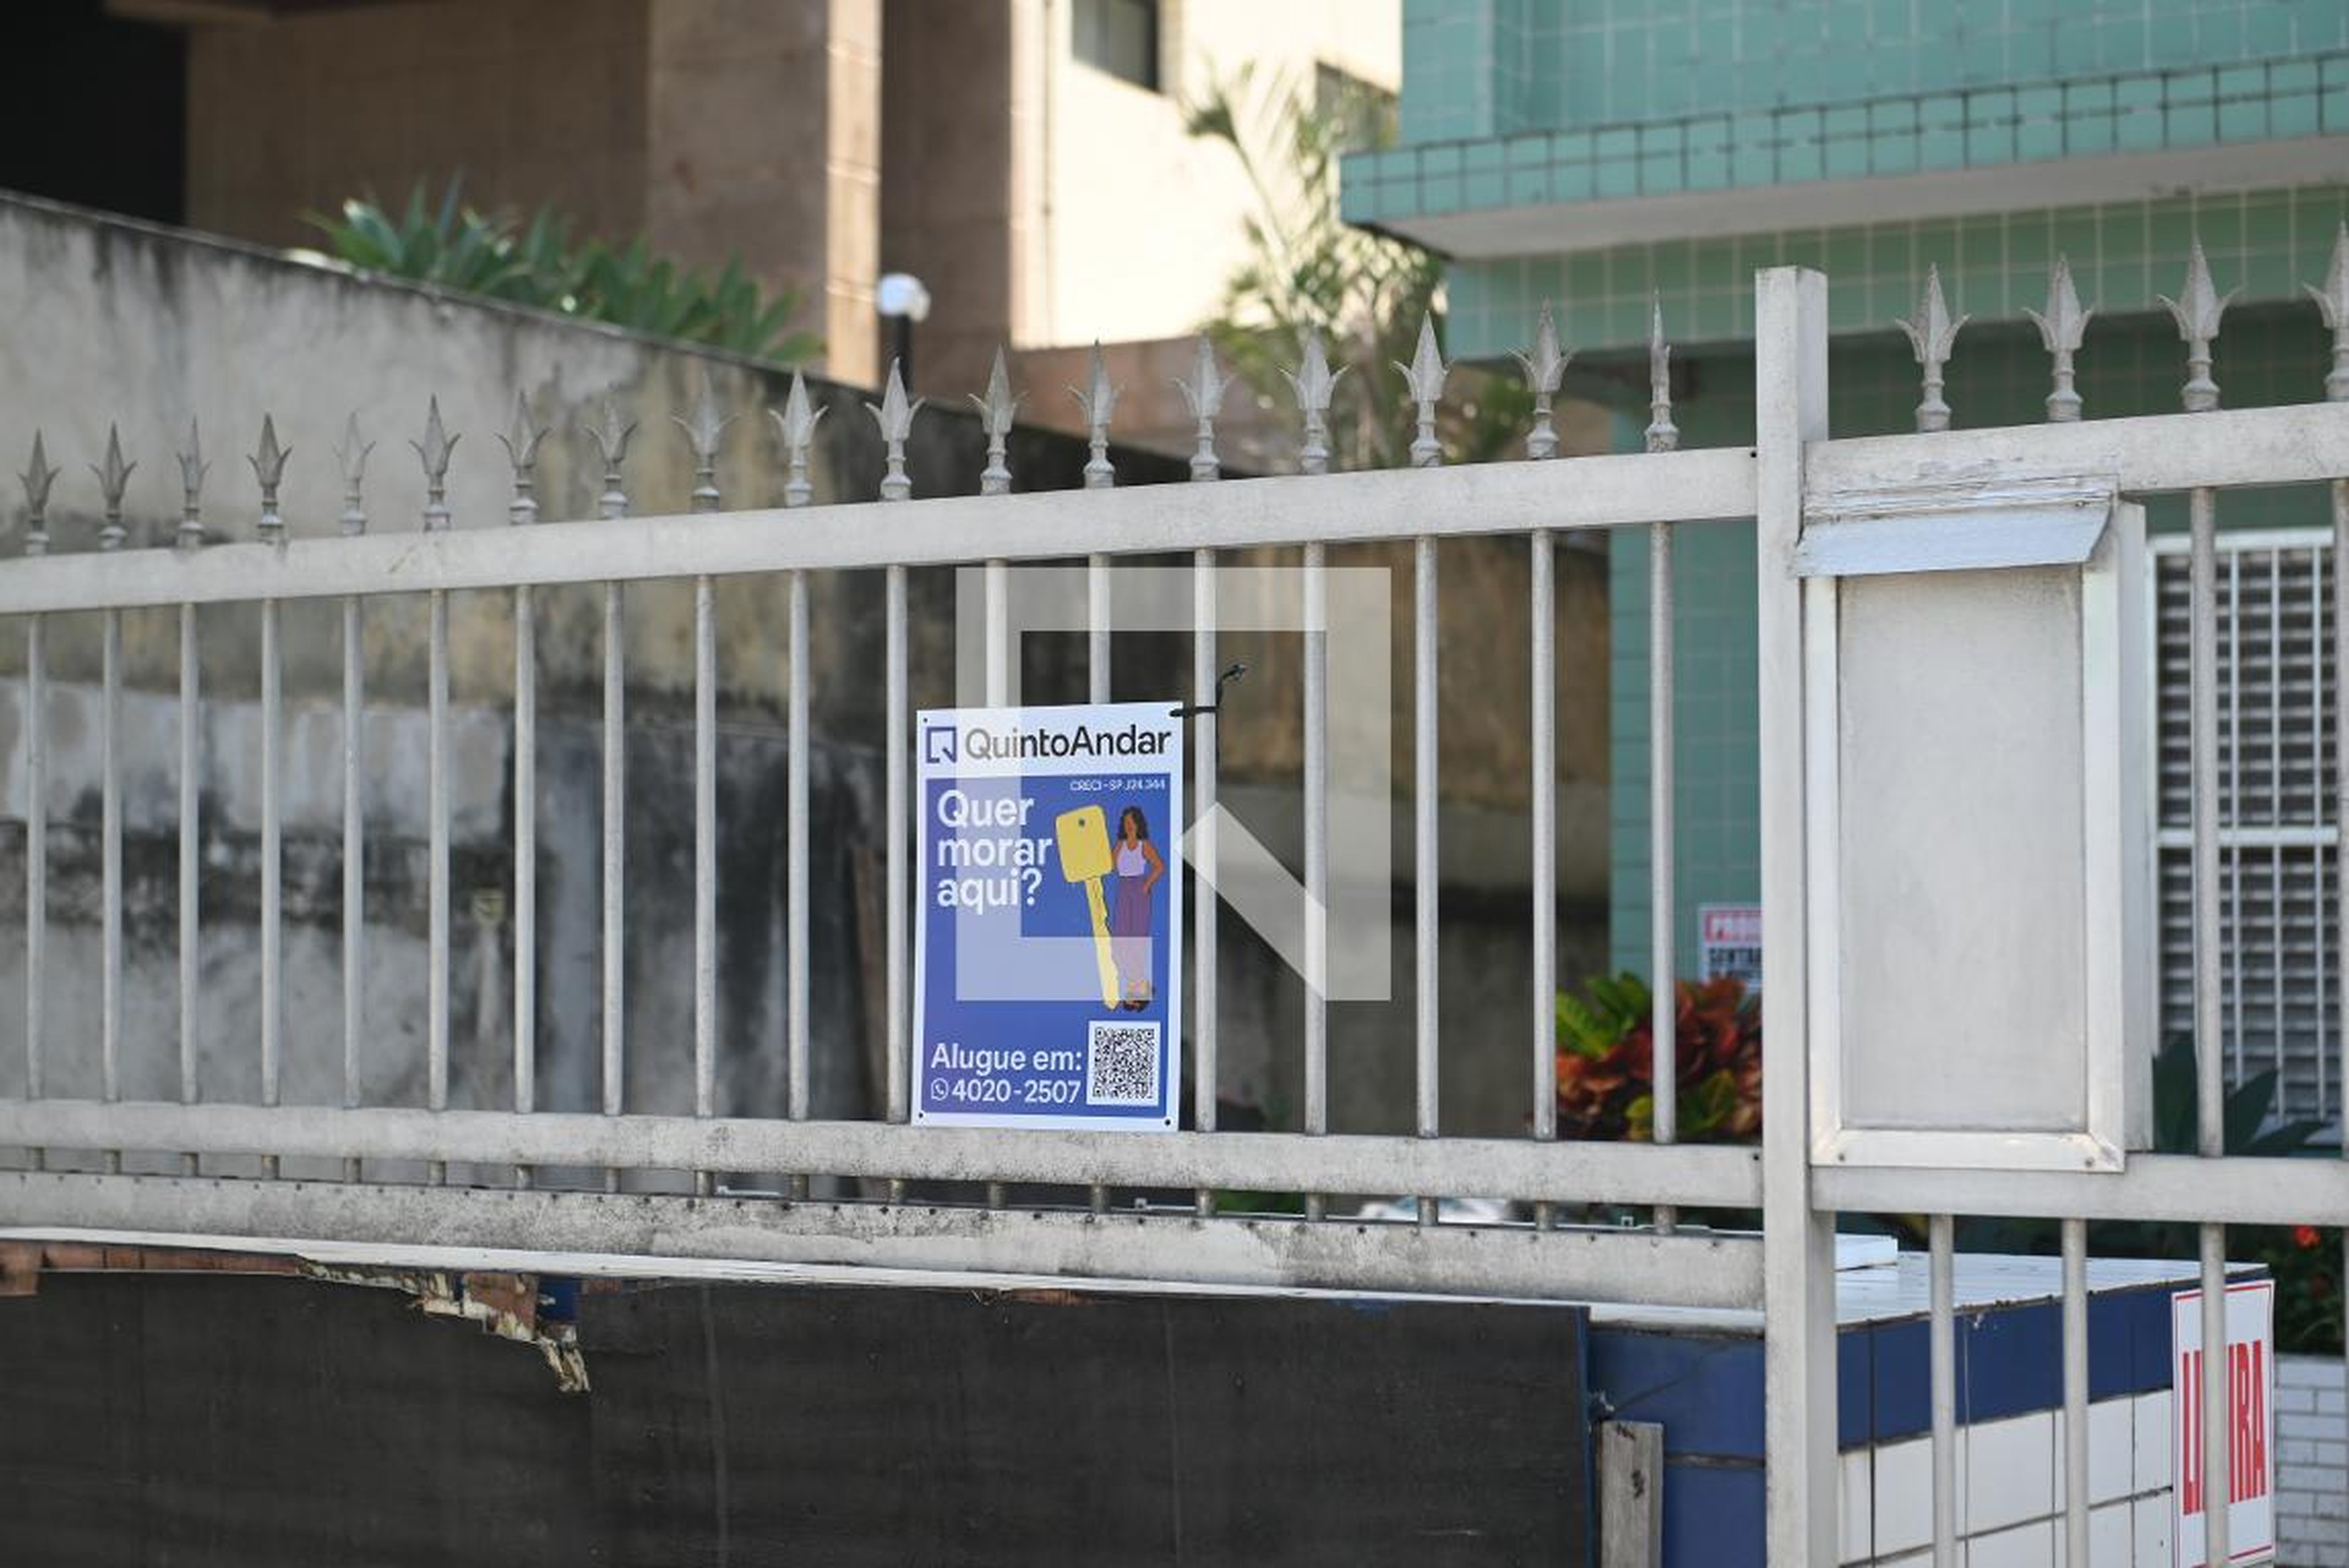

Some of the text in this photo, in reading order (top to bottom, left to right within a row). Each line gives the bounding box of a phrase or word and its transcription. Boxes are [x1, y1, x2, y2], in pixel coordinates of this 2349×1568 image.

[965, 725, 1171, 760] QuintoAndar
[937, 790, 1034, 828] Quer
[938, 838, 1052, 867] morar
[938, 868, 1042, 915] aqui?
[930, 1043, 1082, 1076] Alugue em:
[952, 1080, 1080, 1103] 4020-2507
